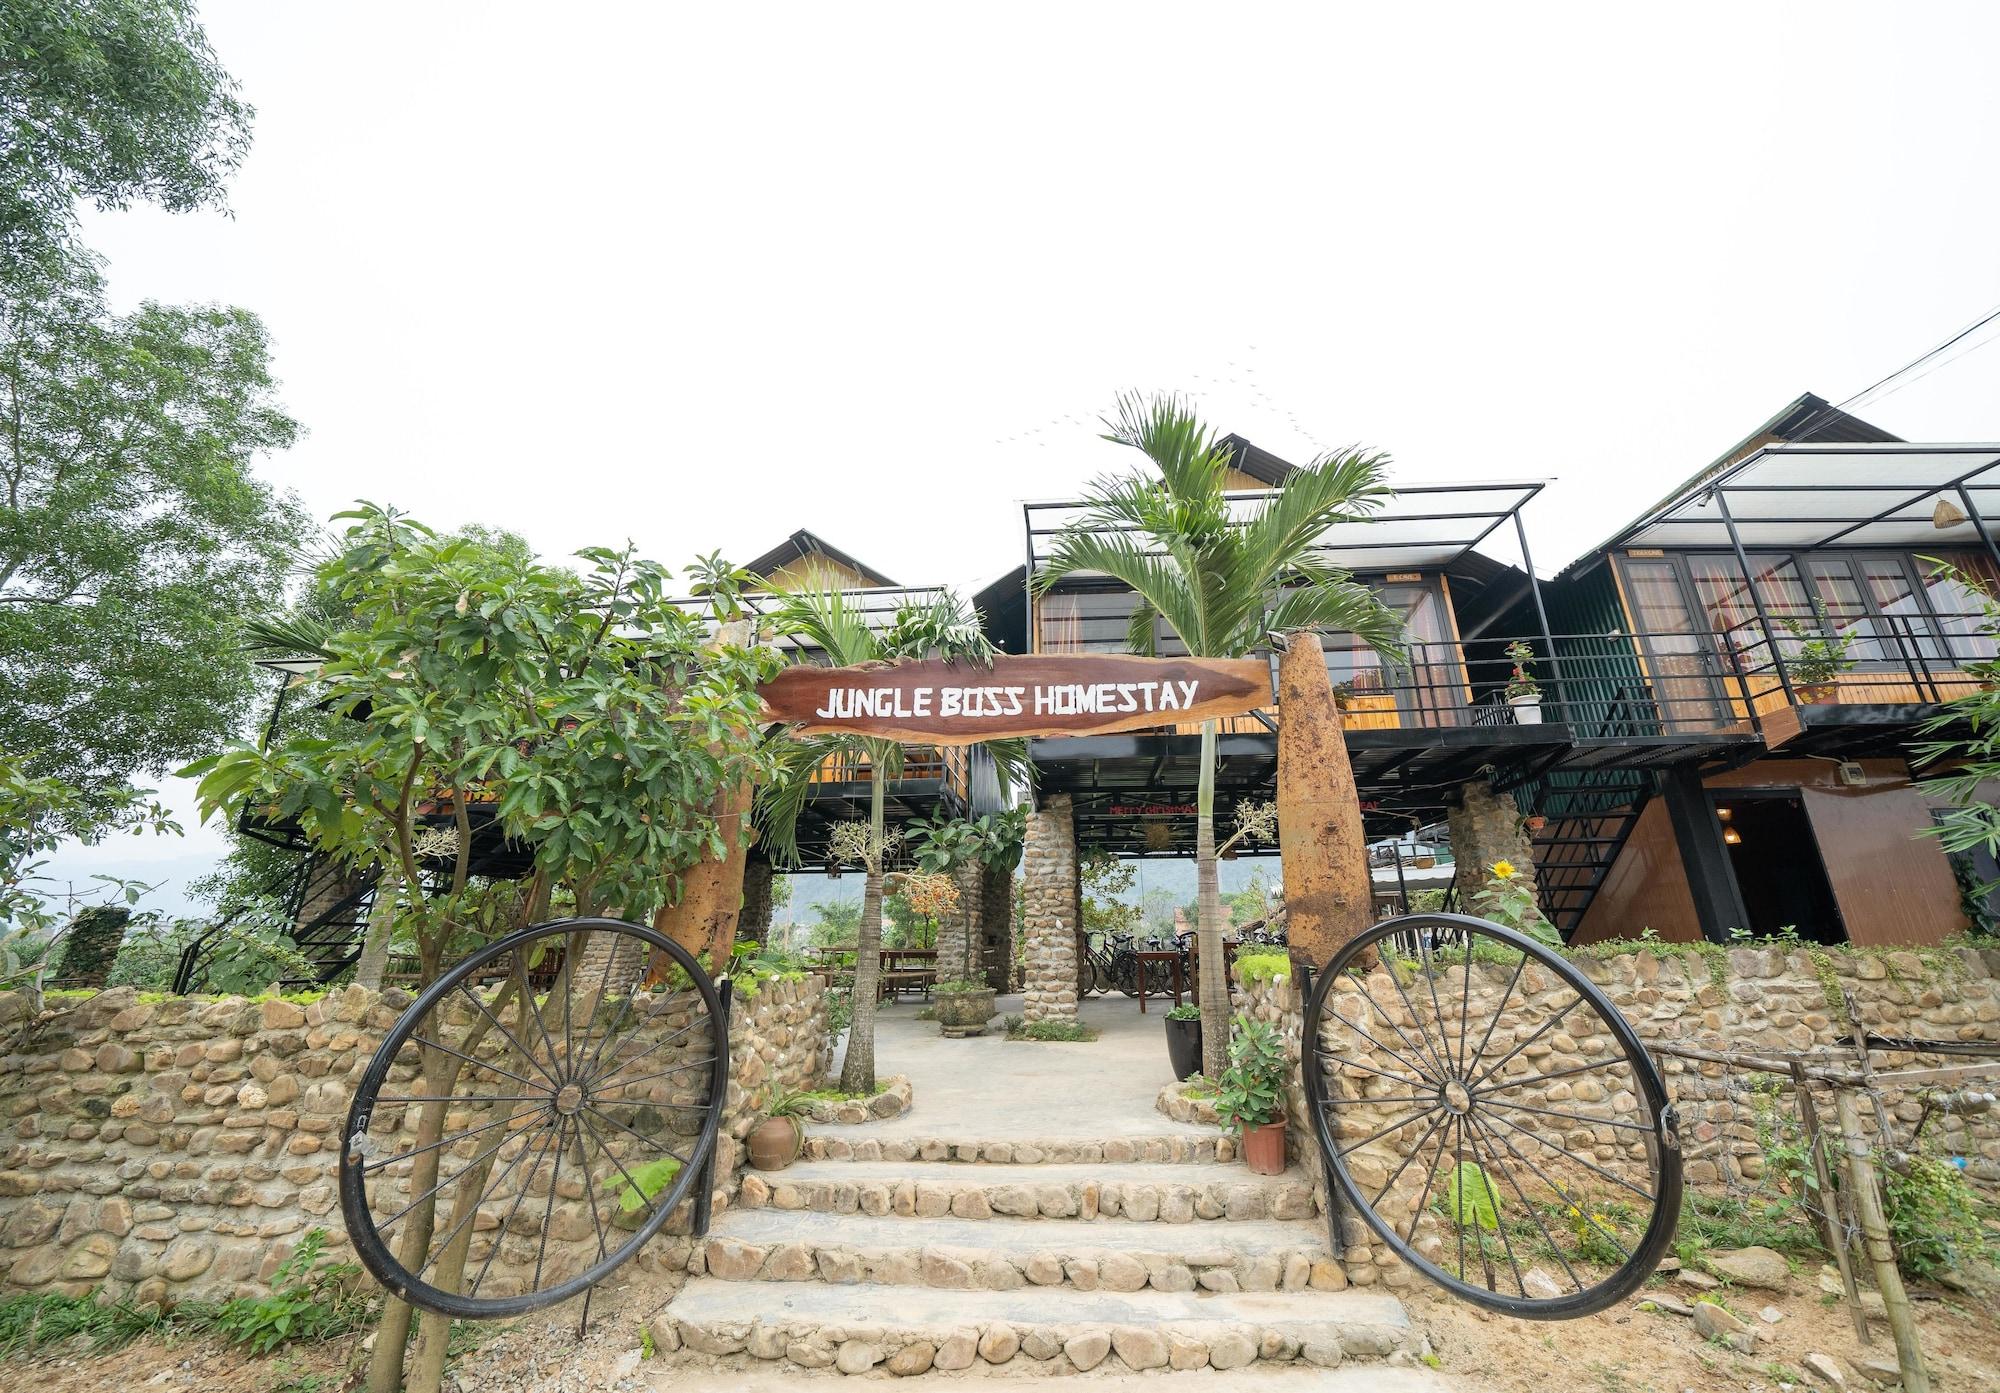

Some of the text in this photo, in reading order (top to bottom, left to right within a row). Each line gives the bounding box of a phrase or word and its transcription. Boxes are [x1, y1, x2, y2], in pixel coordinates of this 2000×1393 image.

[816, 680, 1199, 719] JUNGLE BOSS HOMESTAY
